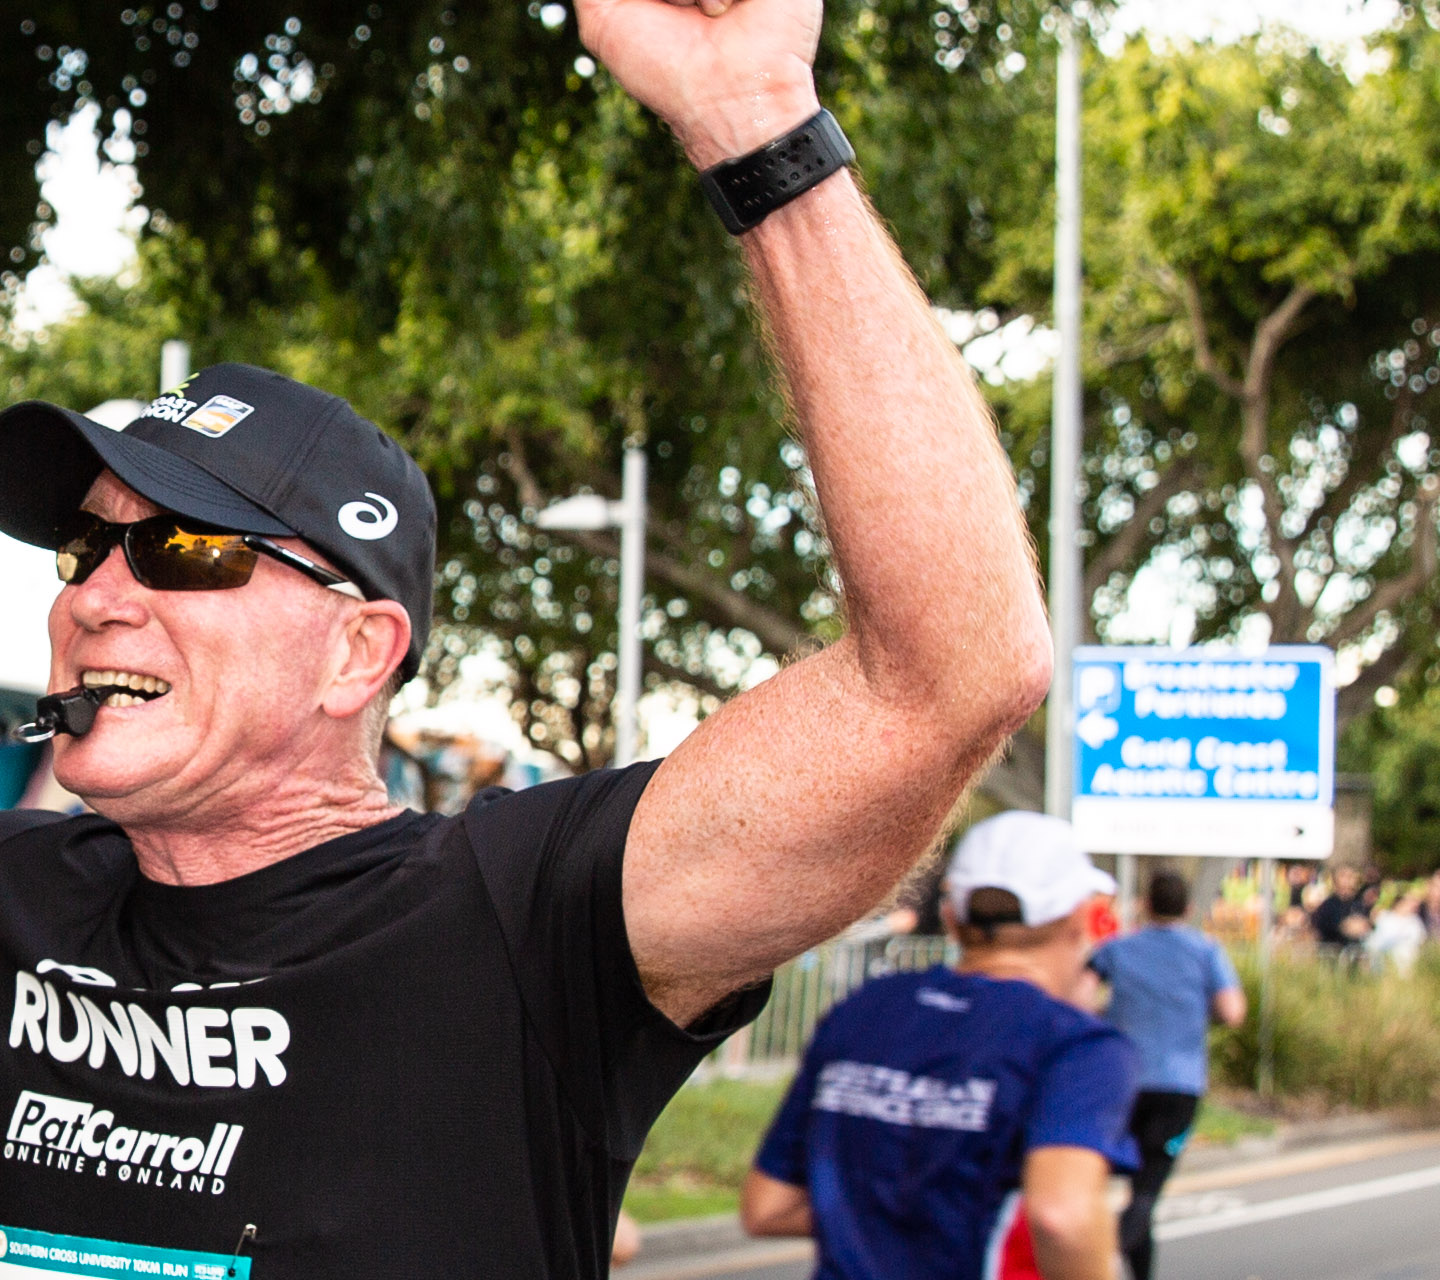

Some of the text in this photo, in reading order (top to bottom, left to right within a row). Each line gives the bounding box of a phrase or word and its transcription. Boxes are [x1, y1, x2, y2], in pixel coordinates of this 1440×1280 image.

[1121, 736, 1288, 770] Gold Coast
[1091, 765, 1318, 797] Aquatic Centre
[9, 971, 291, 1089] RUNNER
[4, 1142, 225, 1195] ONLINE & ONLAND
[9, 1241, 49, 1260] SOUTHERN
[49, 1248, 78, 1264] CROSS
[79, 1251, 132, 1271] UNIVERSITY
[133, 1258, 161, 1275] 10KM
[162, 1262, 189, 1278] RUN
